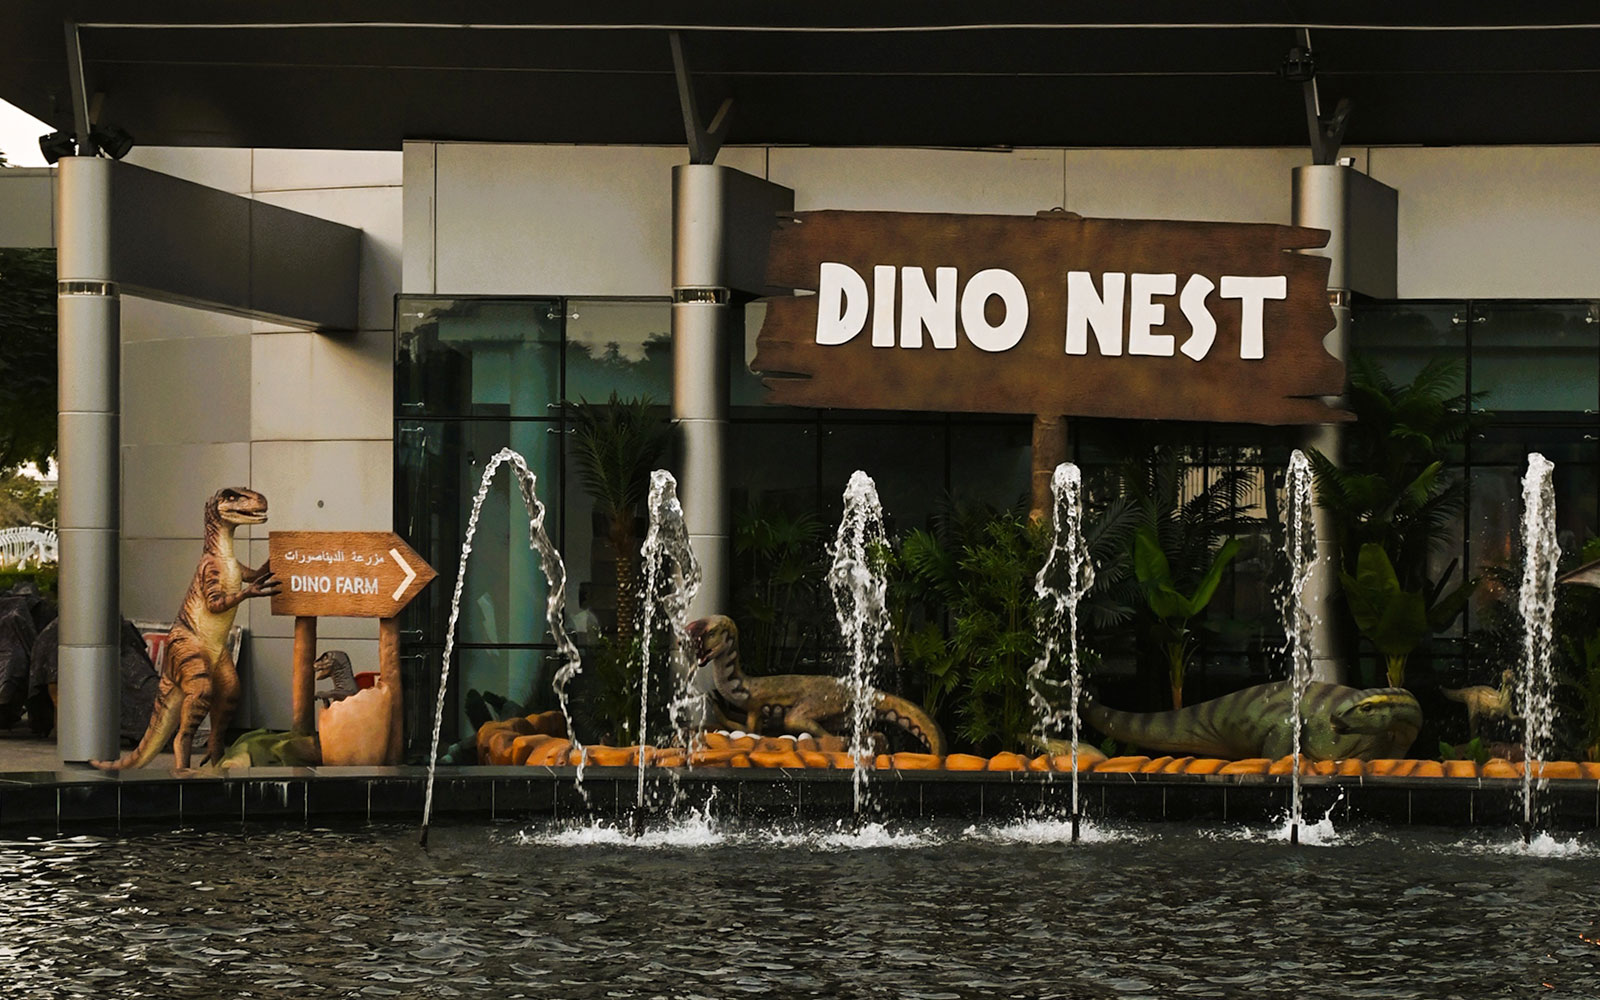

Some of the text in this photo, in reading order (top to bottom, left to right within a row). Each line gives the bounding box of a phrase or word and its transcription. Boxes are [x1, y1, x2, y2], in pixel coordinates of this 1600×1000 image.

[816, 262, 1287, 361] DINO NEST
[285, 550, 384, 565] مزرعة الديناصورات
[291, 575, 378, 594] DINO FARM
